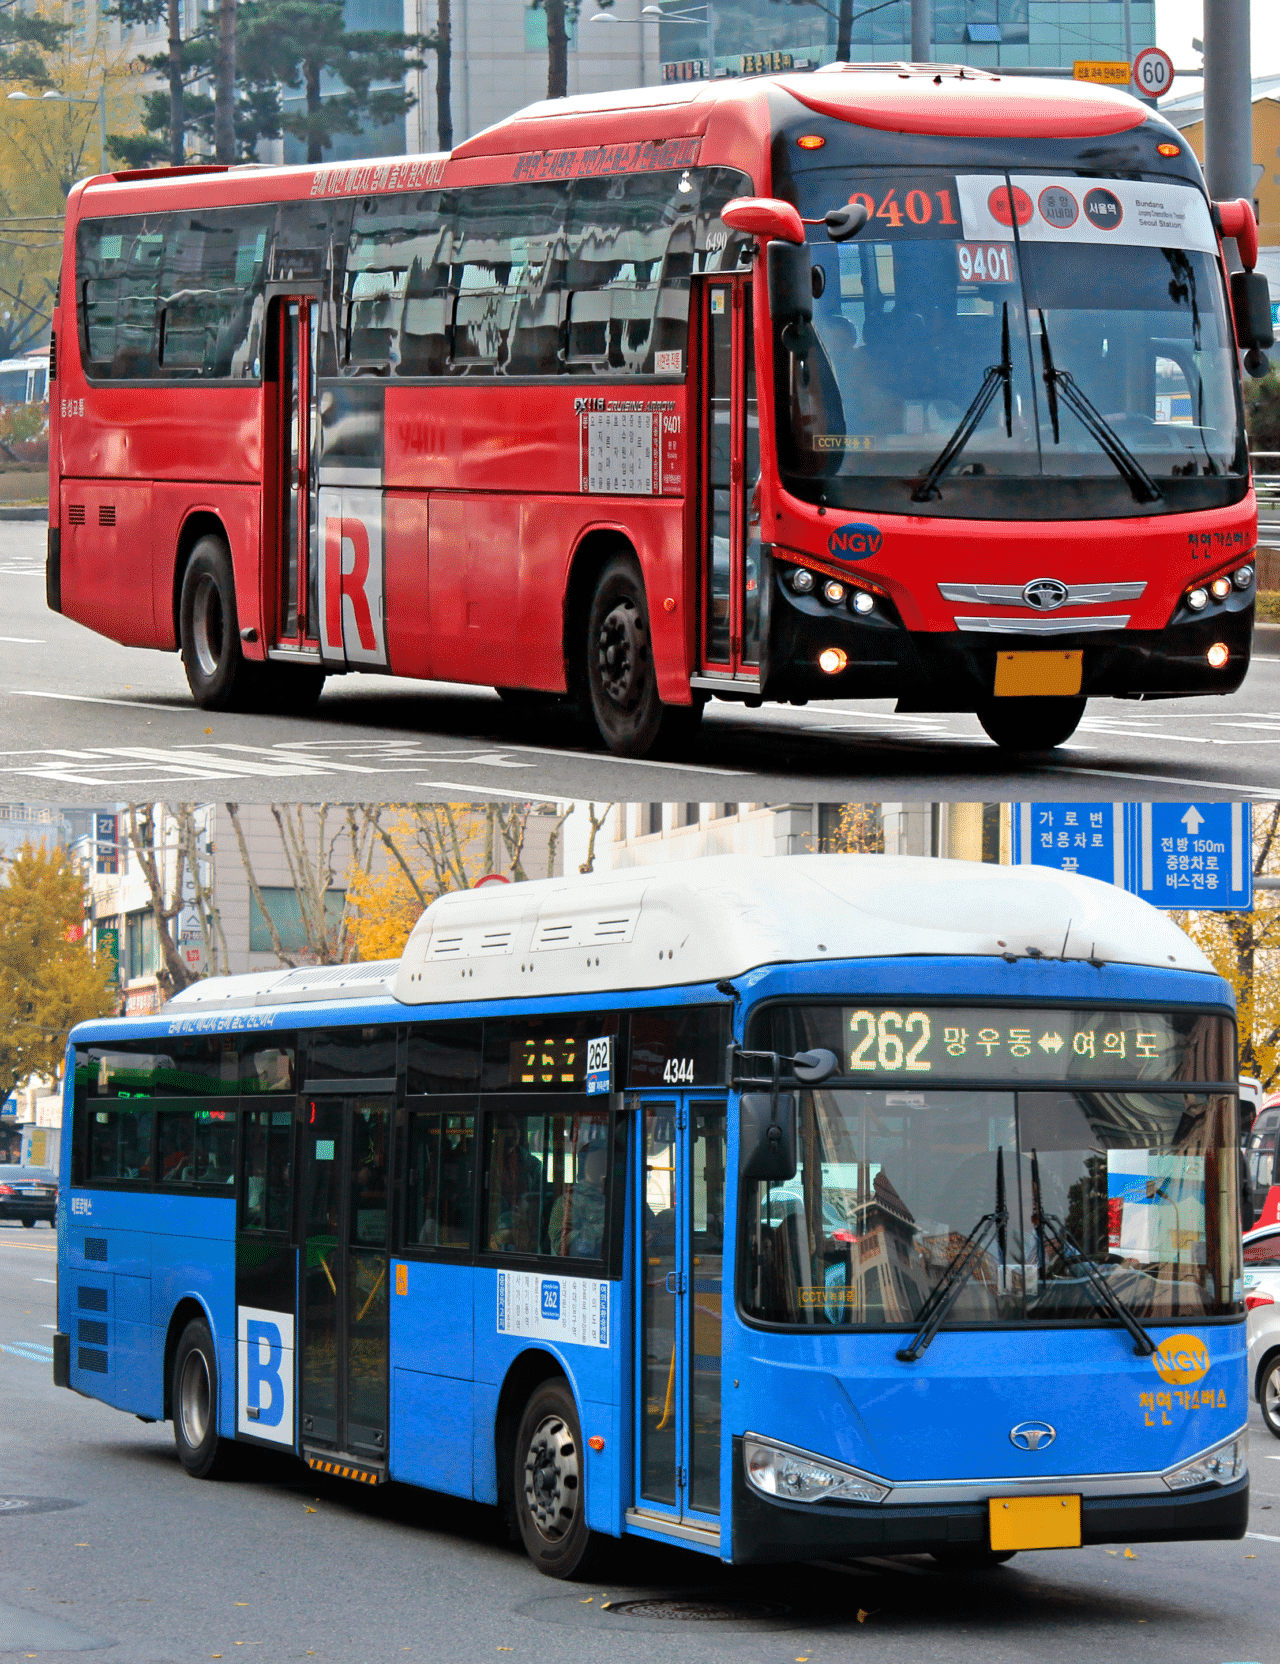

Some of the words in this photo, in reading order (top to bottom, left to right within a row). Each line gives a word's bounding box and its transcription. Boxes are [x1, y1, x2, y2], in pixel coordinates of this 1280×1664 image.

[1144, 62, 1164, 84] 60
[1089, 203, 1117, 215] 서울역
[1135, 200, 1164, 210] Bundang
[1138, 219, 1157, 228] Seoul
[1158, 220, 1182, 229] Station
[706, 231, 728, 251] 6490
[959, 246, 1010, 280] 9401
[645, 400, 676, 412] ARROW
[663, 416, 681, 434] 9401
[818, 438, 842, 448] CCTV
[831, 532, 882, 552] NGV
[1188, 532, 1250, 559] 천연가스버스
[326, 517, 376, 651] R
[1039, 810, 1104, 828] 가로변
[1040, 831, 1104, 850] 전용차로
[1160, 837, 1190, 855] 전방
[1192, 838, 1226, 854] 150m
[1062, 856, 1080, 873] 끝
[1166, 854, 1220, 872] 중앙차로
[1165, 872, 1220, 890] 버스전용
[850, 1010, 932, 1072] 262
[944, 1026, 1033, 1058] 망우동
[1072, 1030, 1159, 1060] 여의도
[588, 1042, 608, 1071] 262
[663, 1058, 694, 1084] 4344
[544, 1290, 557, 1308] 262
[1156, 1350, 1208, 1372] NGV
[247, 1320, 284, 1427] B
[1138, 1390, 1228, 1427] 천연가스버스
